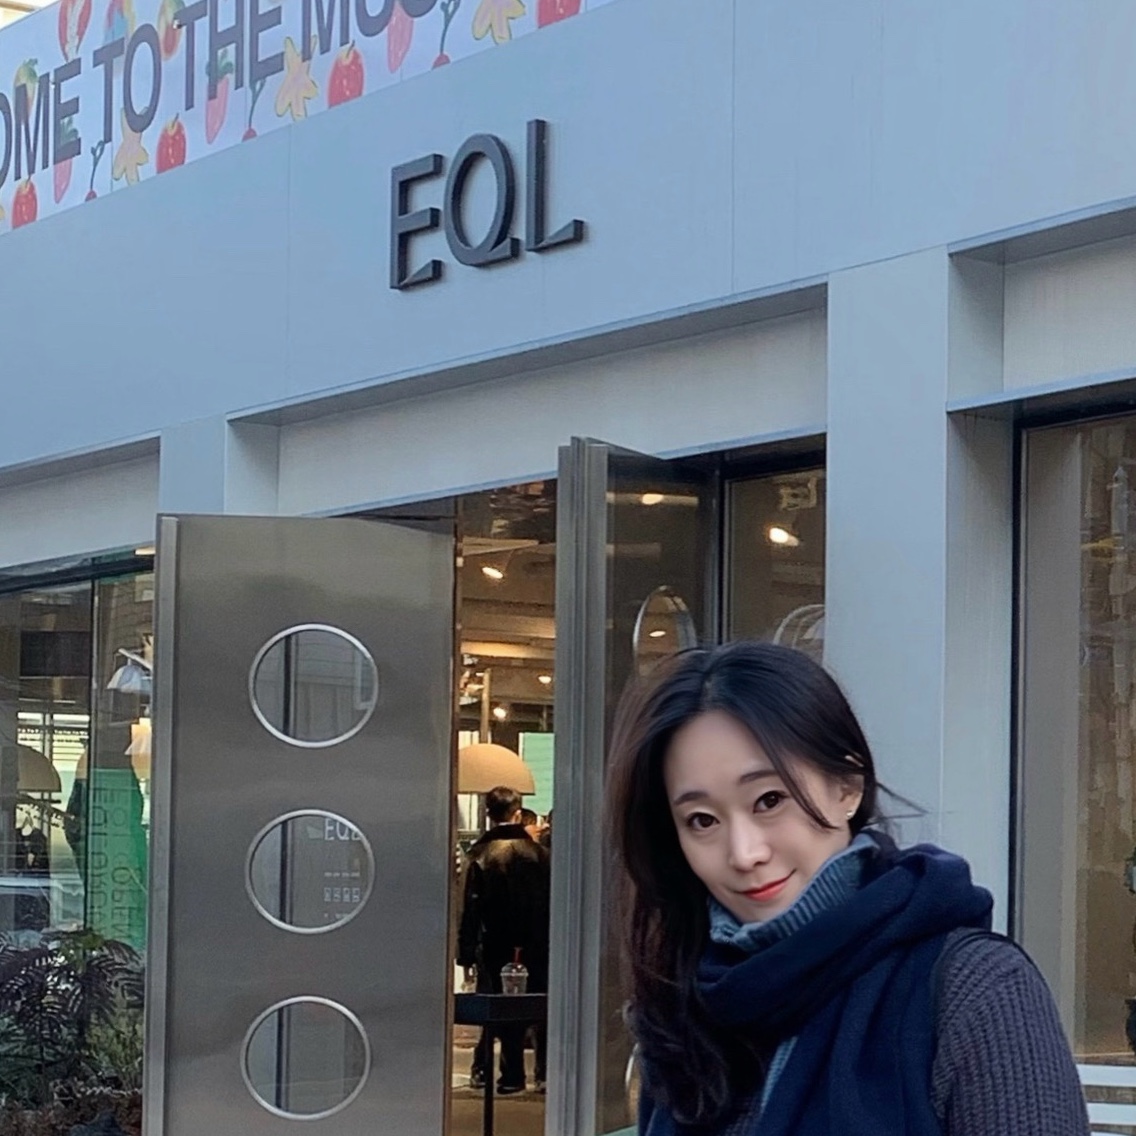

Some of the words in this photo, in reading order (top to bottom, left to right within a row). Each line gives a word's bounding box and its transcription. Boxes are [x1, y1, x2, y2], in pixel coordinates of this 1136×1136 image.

[92, 23, 162, 144] TO
[172, 0, 285, 112] THE
[389, 118, 586, 291] EQL
